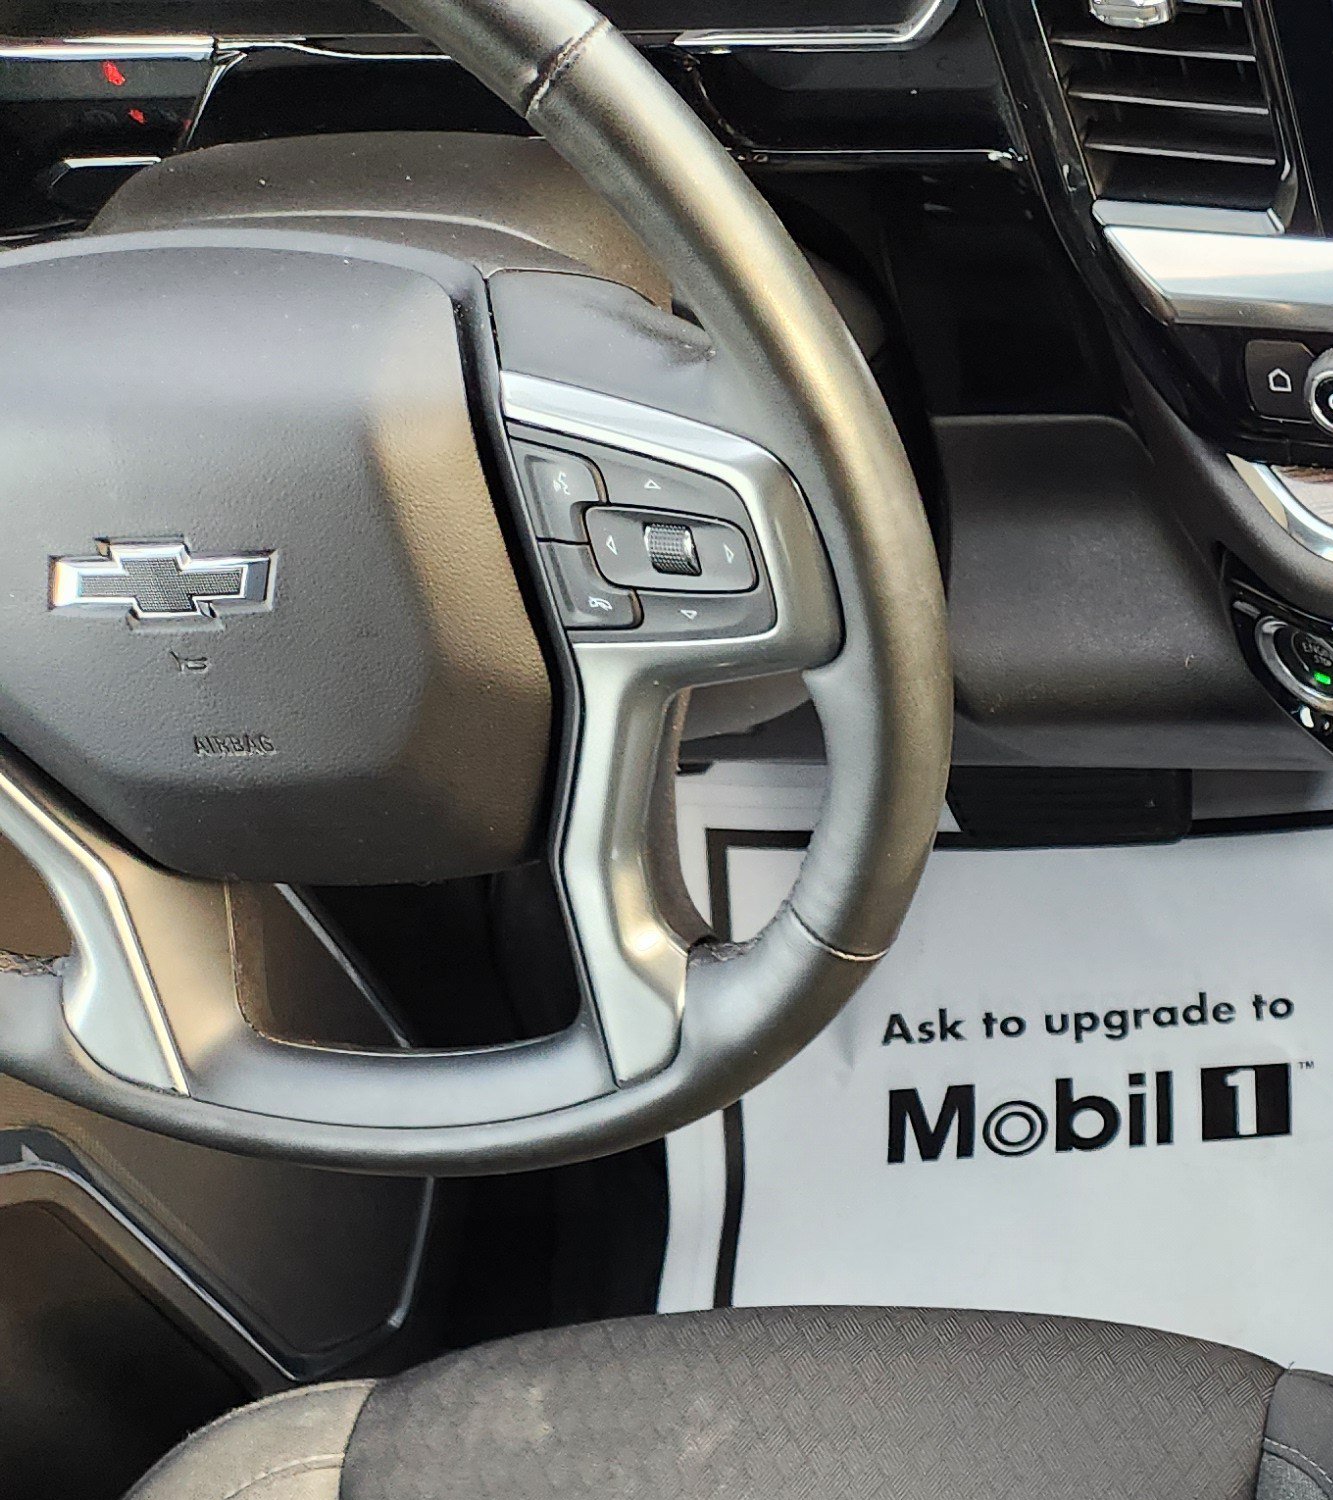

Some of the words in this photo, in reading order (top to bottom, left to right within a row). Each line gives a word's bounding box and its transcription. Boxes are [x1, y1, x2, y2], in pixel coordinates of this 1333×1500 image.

[193, 733, 275, 755] AIRBAG
[881, 1007, 967, 1046] Ask
[982, 1011, 1026, 1039] to
[1044, 992, 1236, 1043] upgrade
[1253, 993, 1295, 1022] to
[887, 1069, 1174, 1165] Mobil
